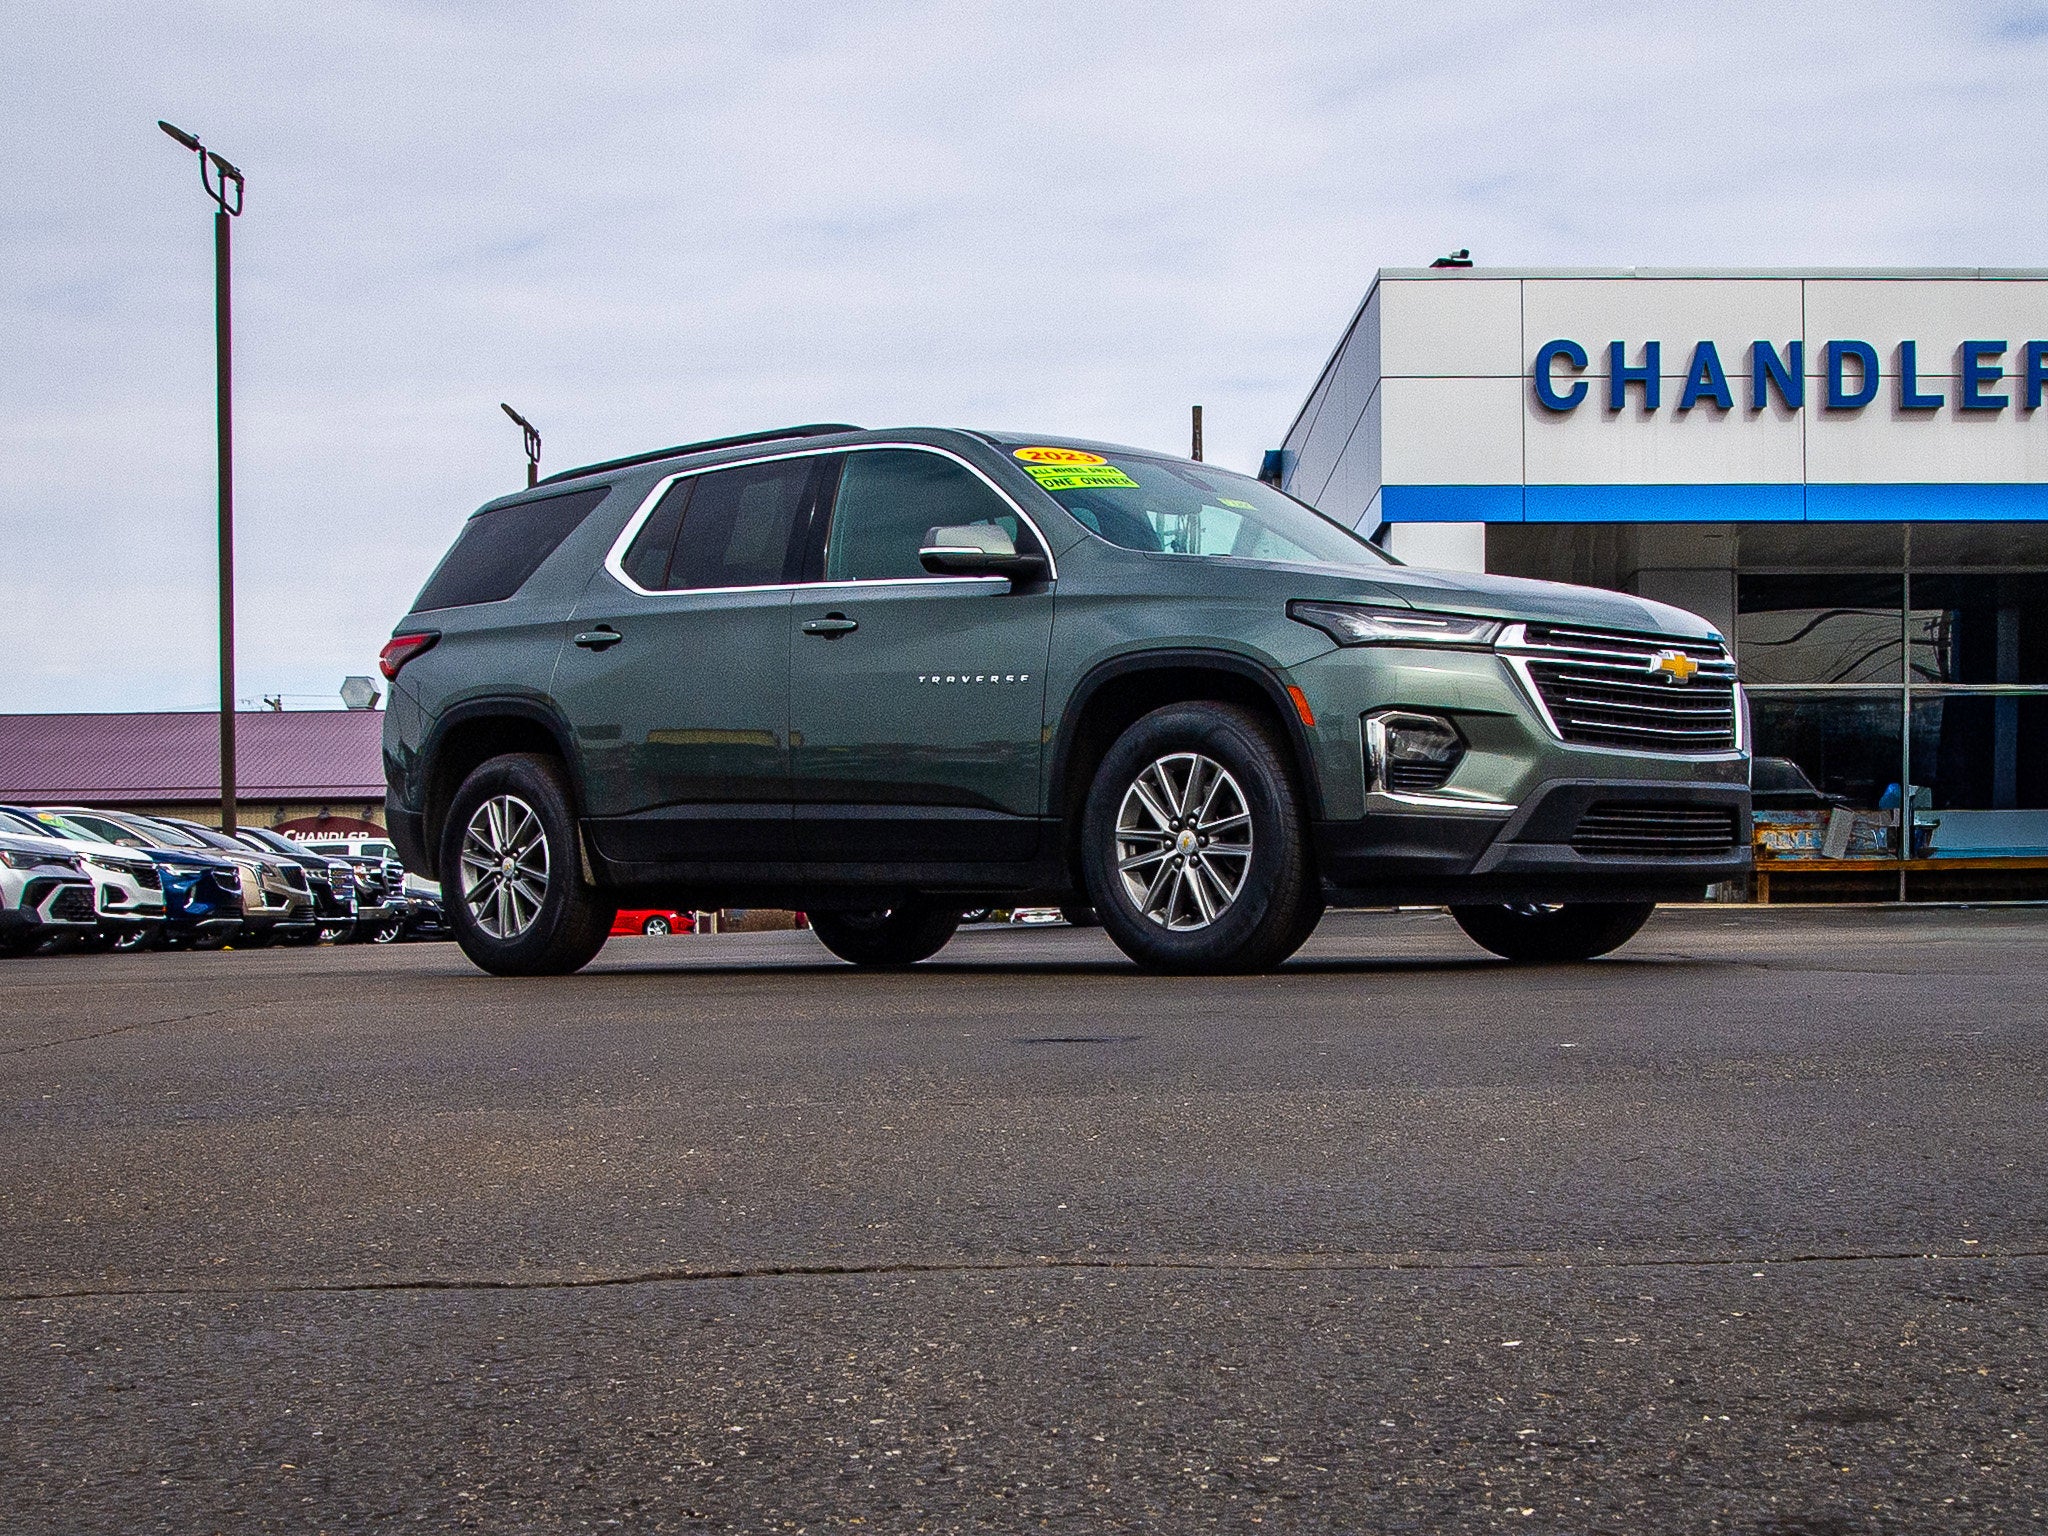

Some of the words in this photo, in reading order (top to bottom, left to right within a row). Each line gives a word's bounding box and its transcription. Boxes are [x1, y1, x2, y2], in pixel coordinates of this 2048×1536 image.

[1026, 450, 1098, 463] 2023
[1031, 467, 1051, 475] ALL
[1052, 466, 1087, 474] WHEEL
[1088, 467, 1121, 475] DRIVE
[1042, 477, 1077, 488] ONE
[1080, 476, 1135, 486] OWNER
[918, 673, 1031, 685] TRAVERSE
